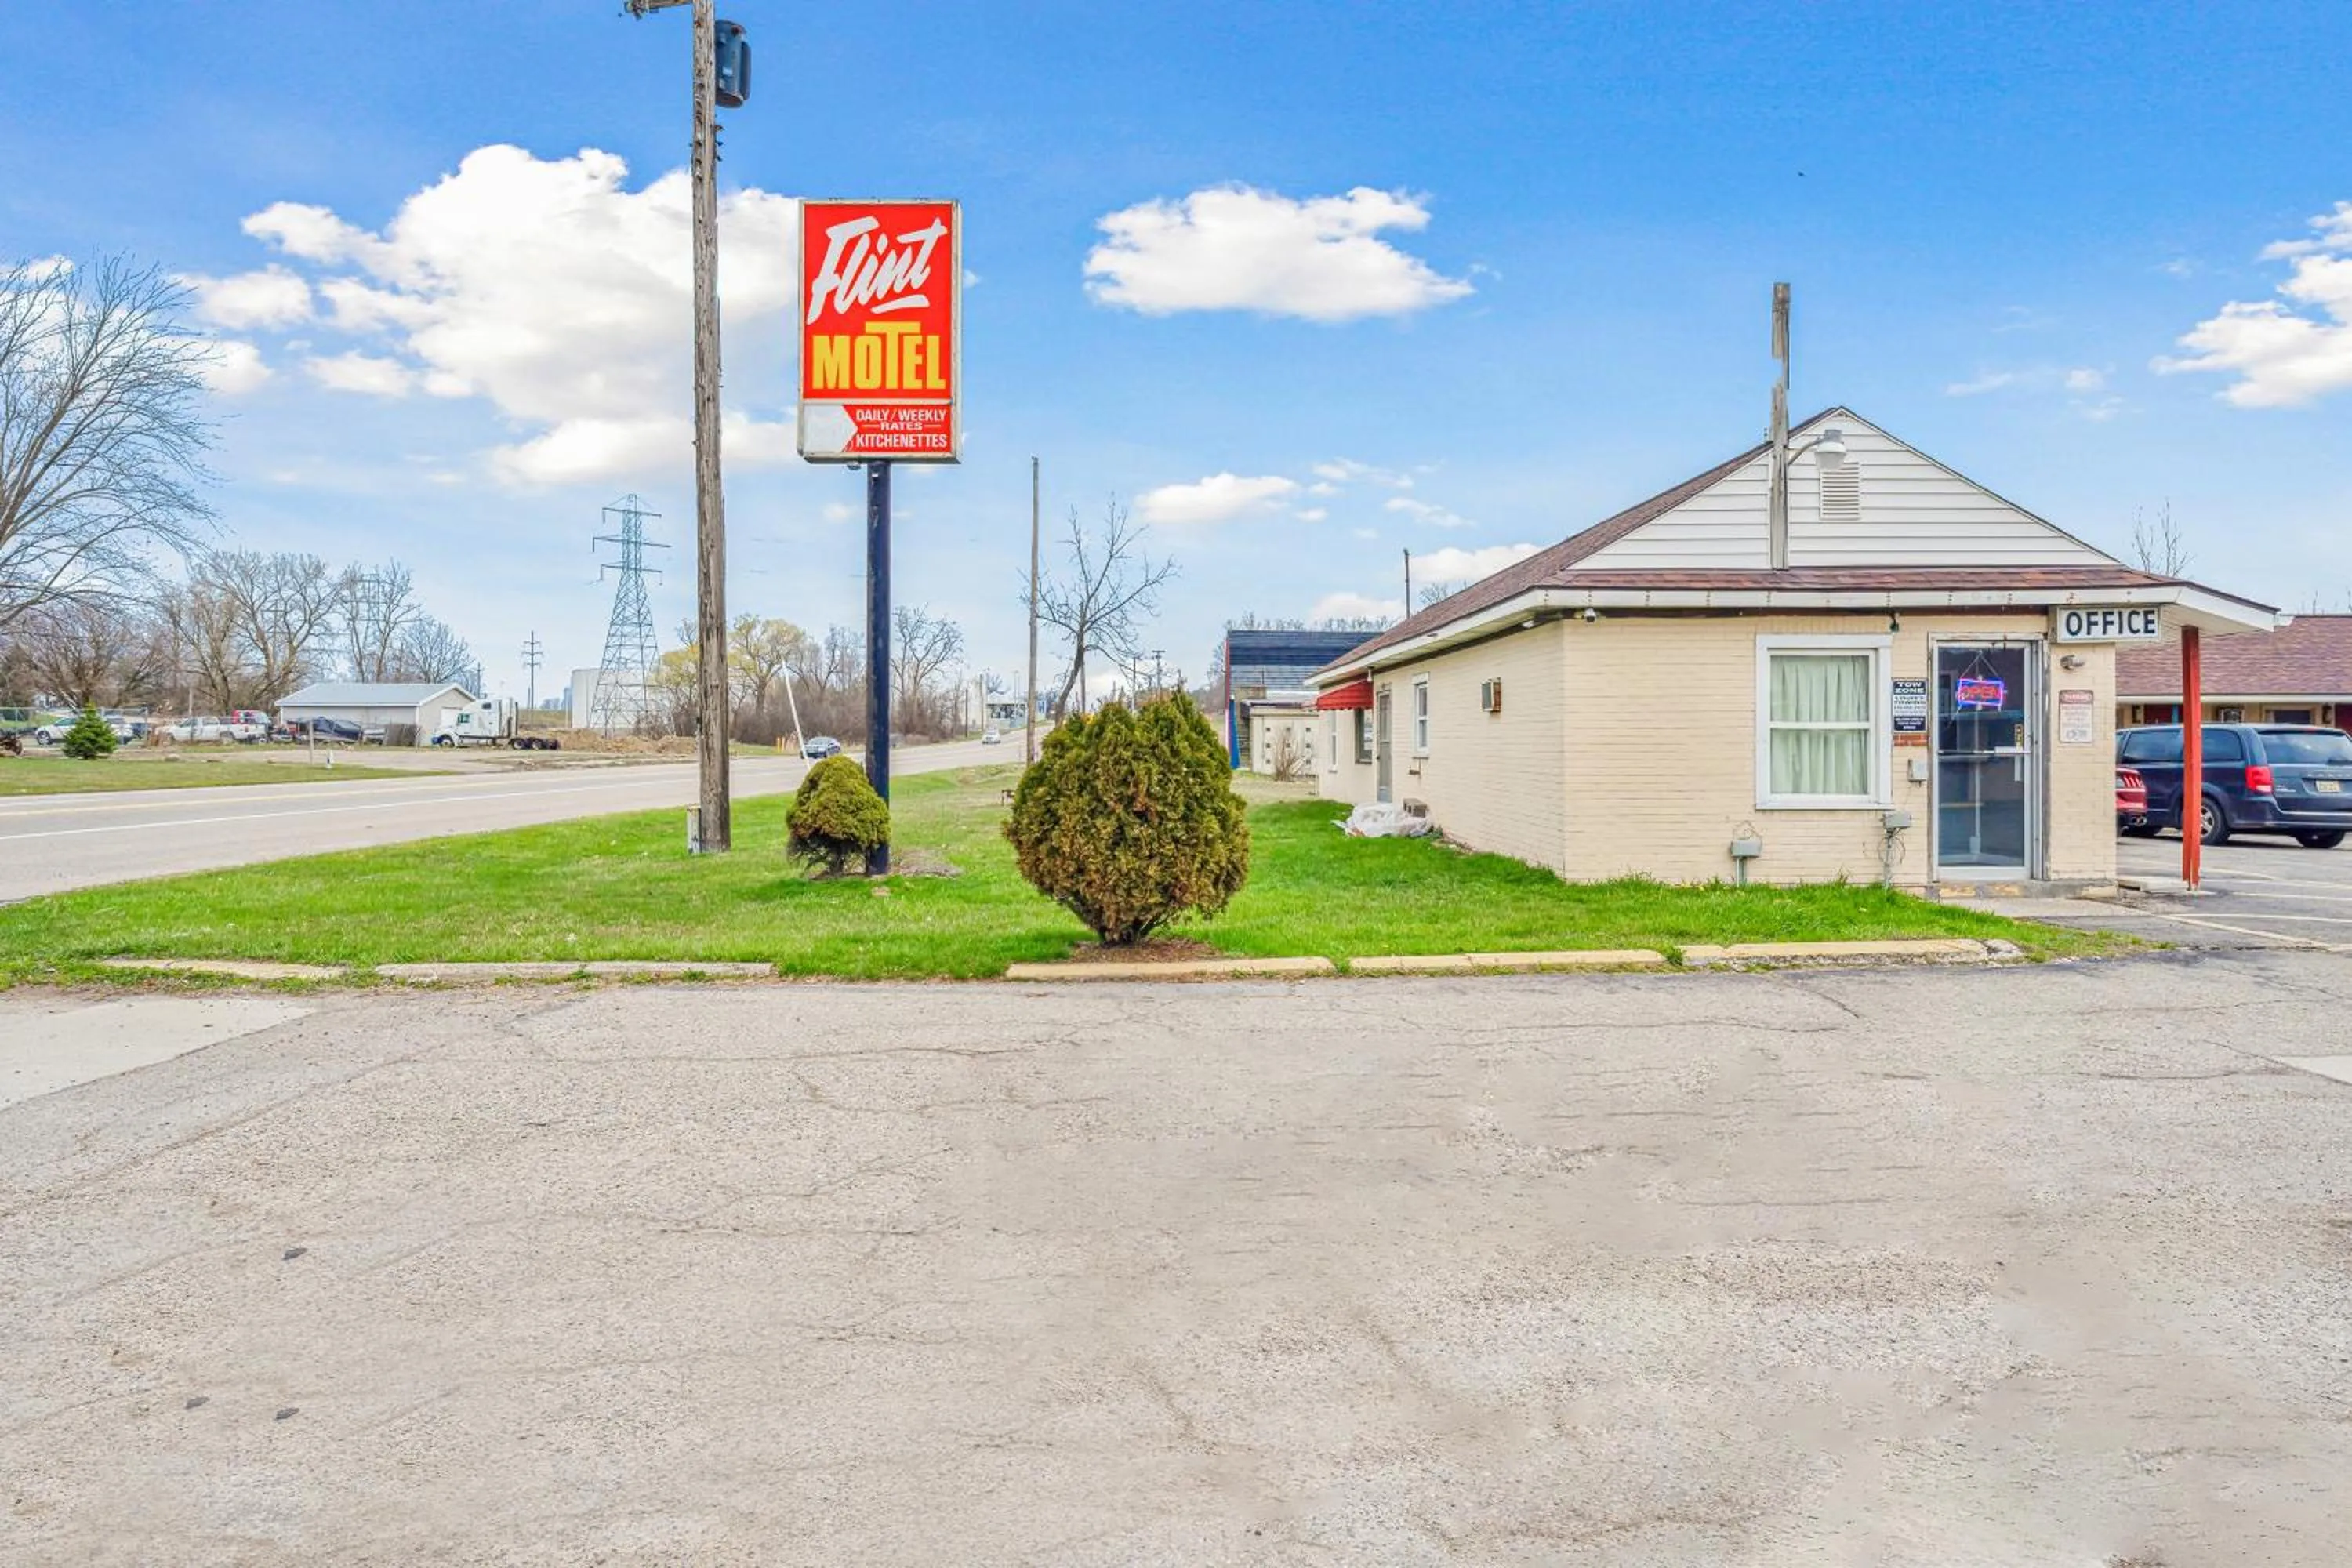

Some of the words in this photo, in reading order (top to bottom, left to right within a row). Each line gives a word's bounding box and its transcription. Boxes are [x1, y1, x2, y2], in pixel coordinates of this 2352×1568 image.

[807, 216, 947, 325] Flint
[812, 321, 946, 390] MOTEL
[880, 422, 923, 430] RATES
[856, 434, 947, 448] KITCHENETTES
[2065, 609, 2156, 636] OFFICE
[1960, 685, 2000, 700] OPEN
